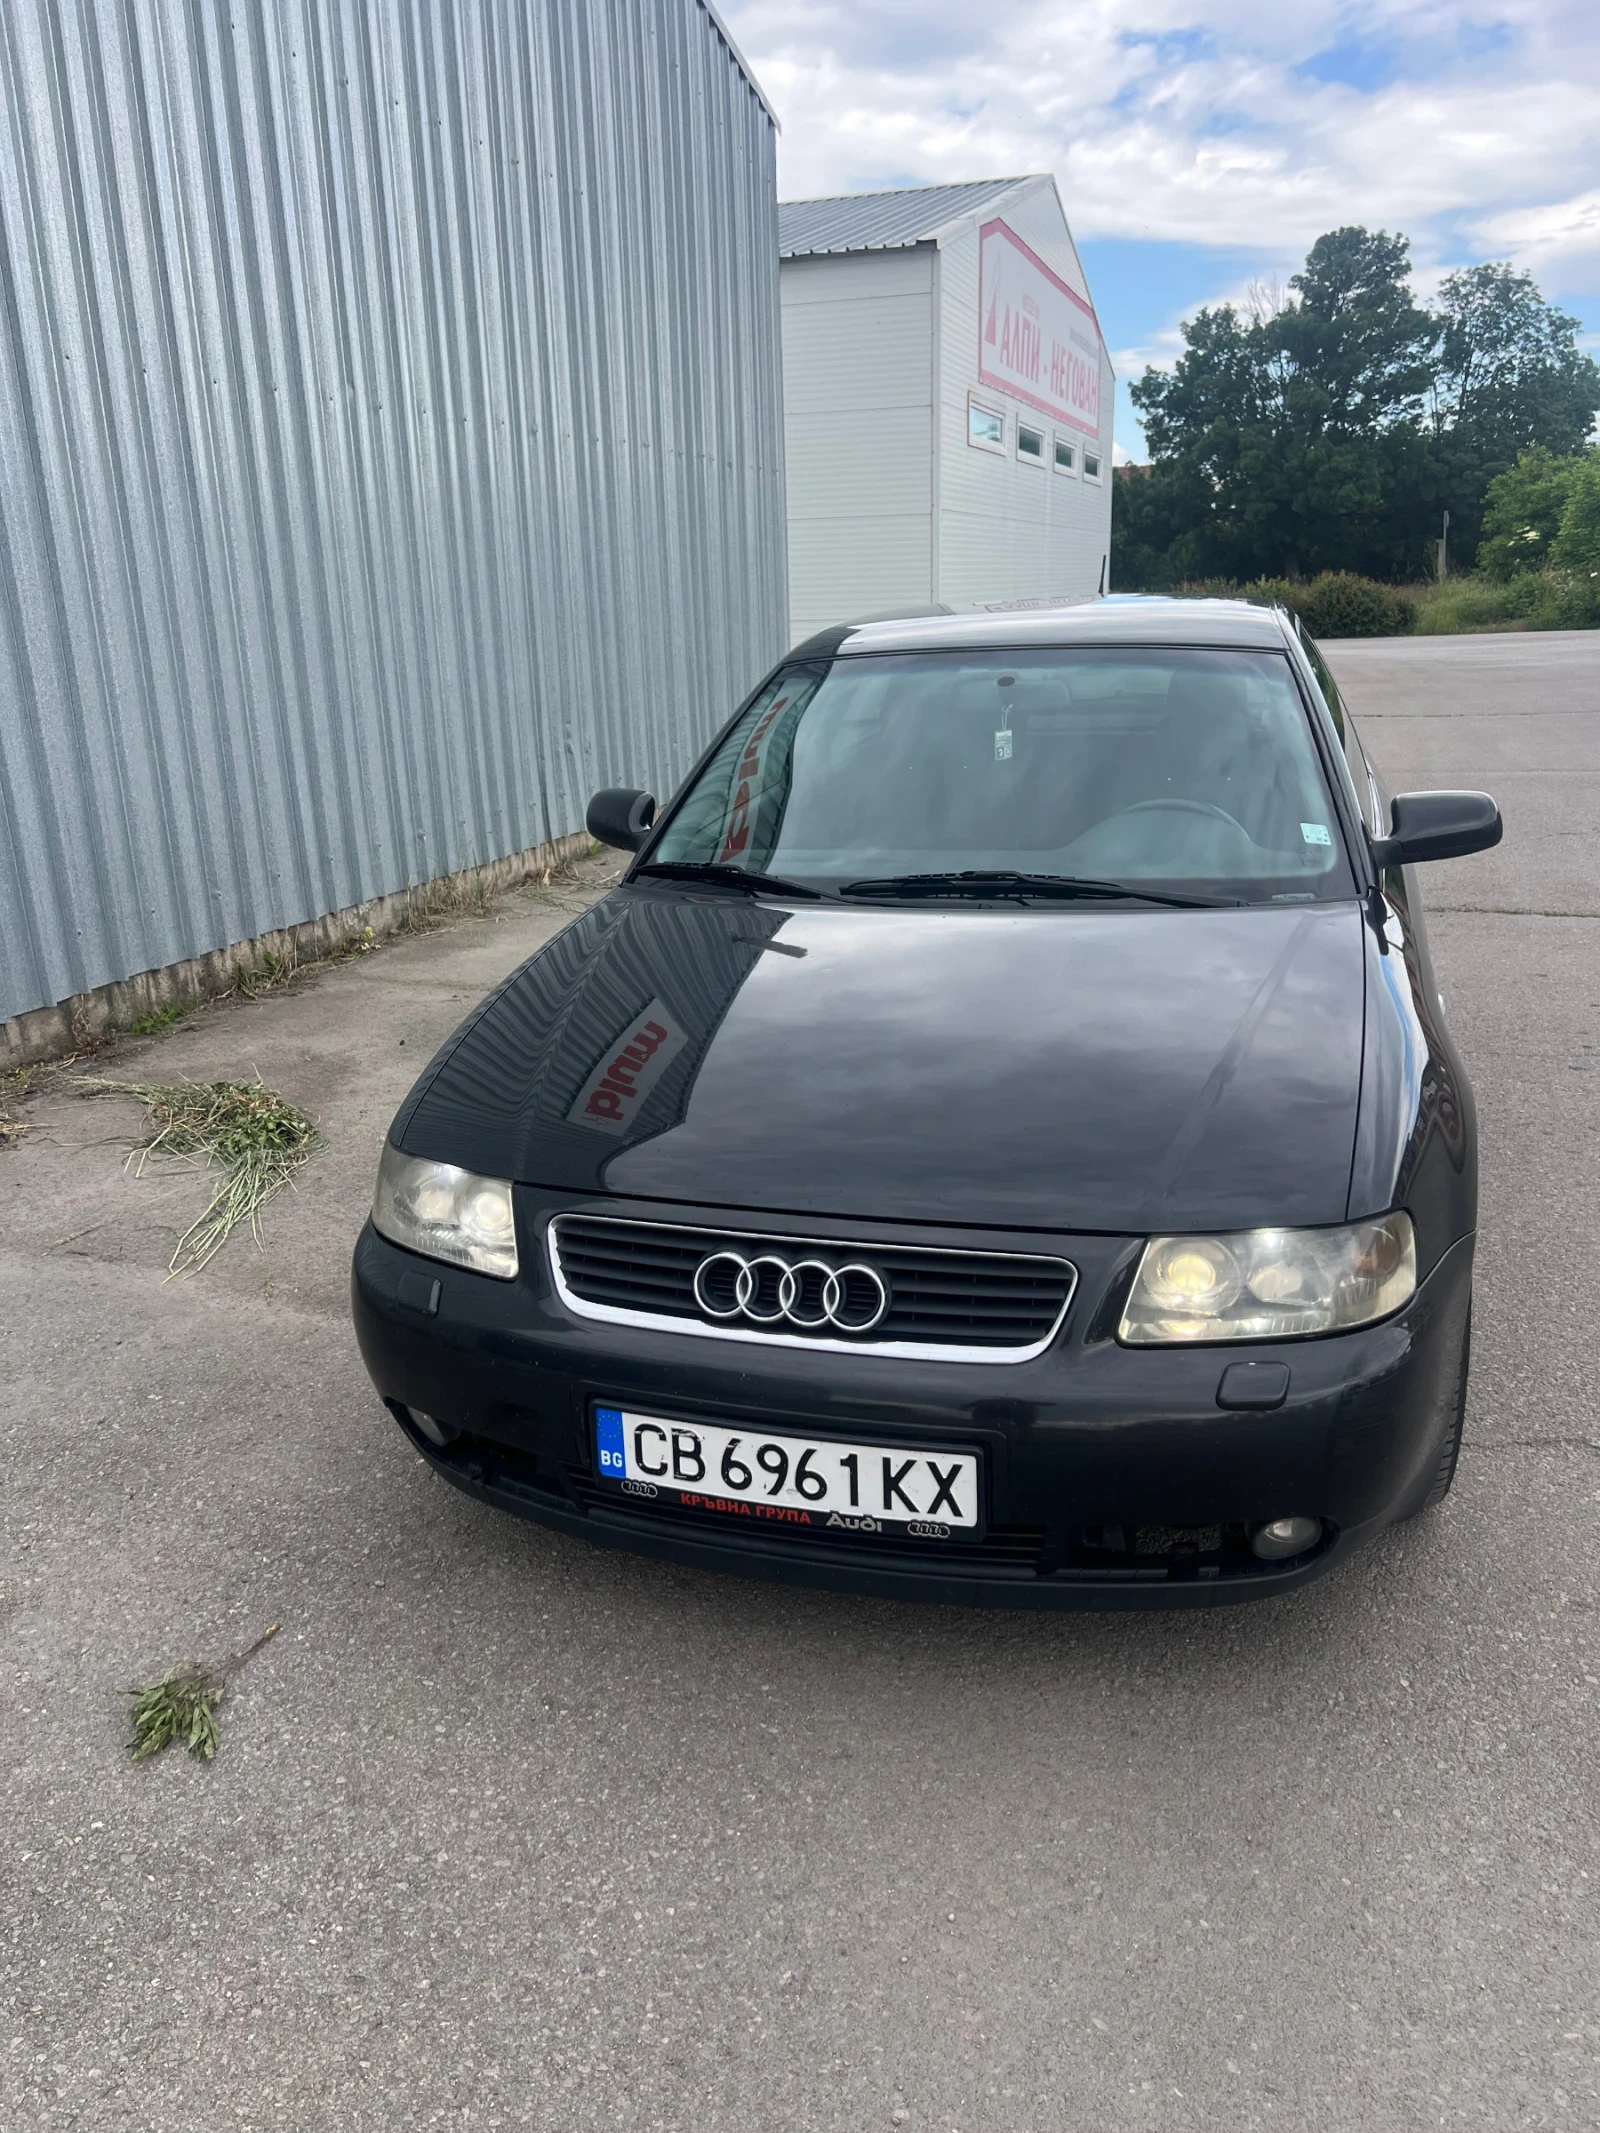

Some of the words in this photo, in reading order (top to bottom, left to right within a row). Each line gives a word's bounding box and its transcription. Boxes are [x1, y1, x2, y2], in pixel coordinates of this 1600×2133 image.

[999, 302, 1041, 384] АЛПИ
[600, 1449, 623, 1468] BG
[680, 1492, 751, 1516] КРЪВНА
[755, 1505, 812, 1525] ГРУПА
[825, 1513, 883, 1532] Audi
